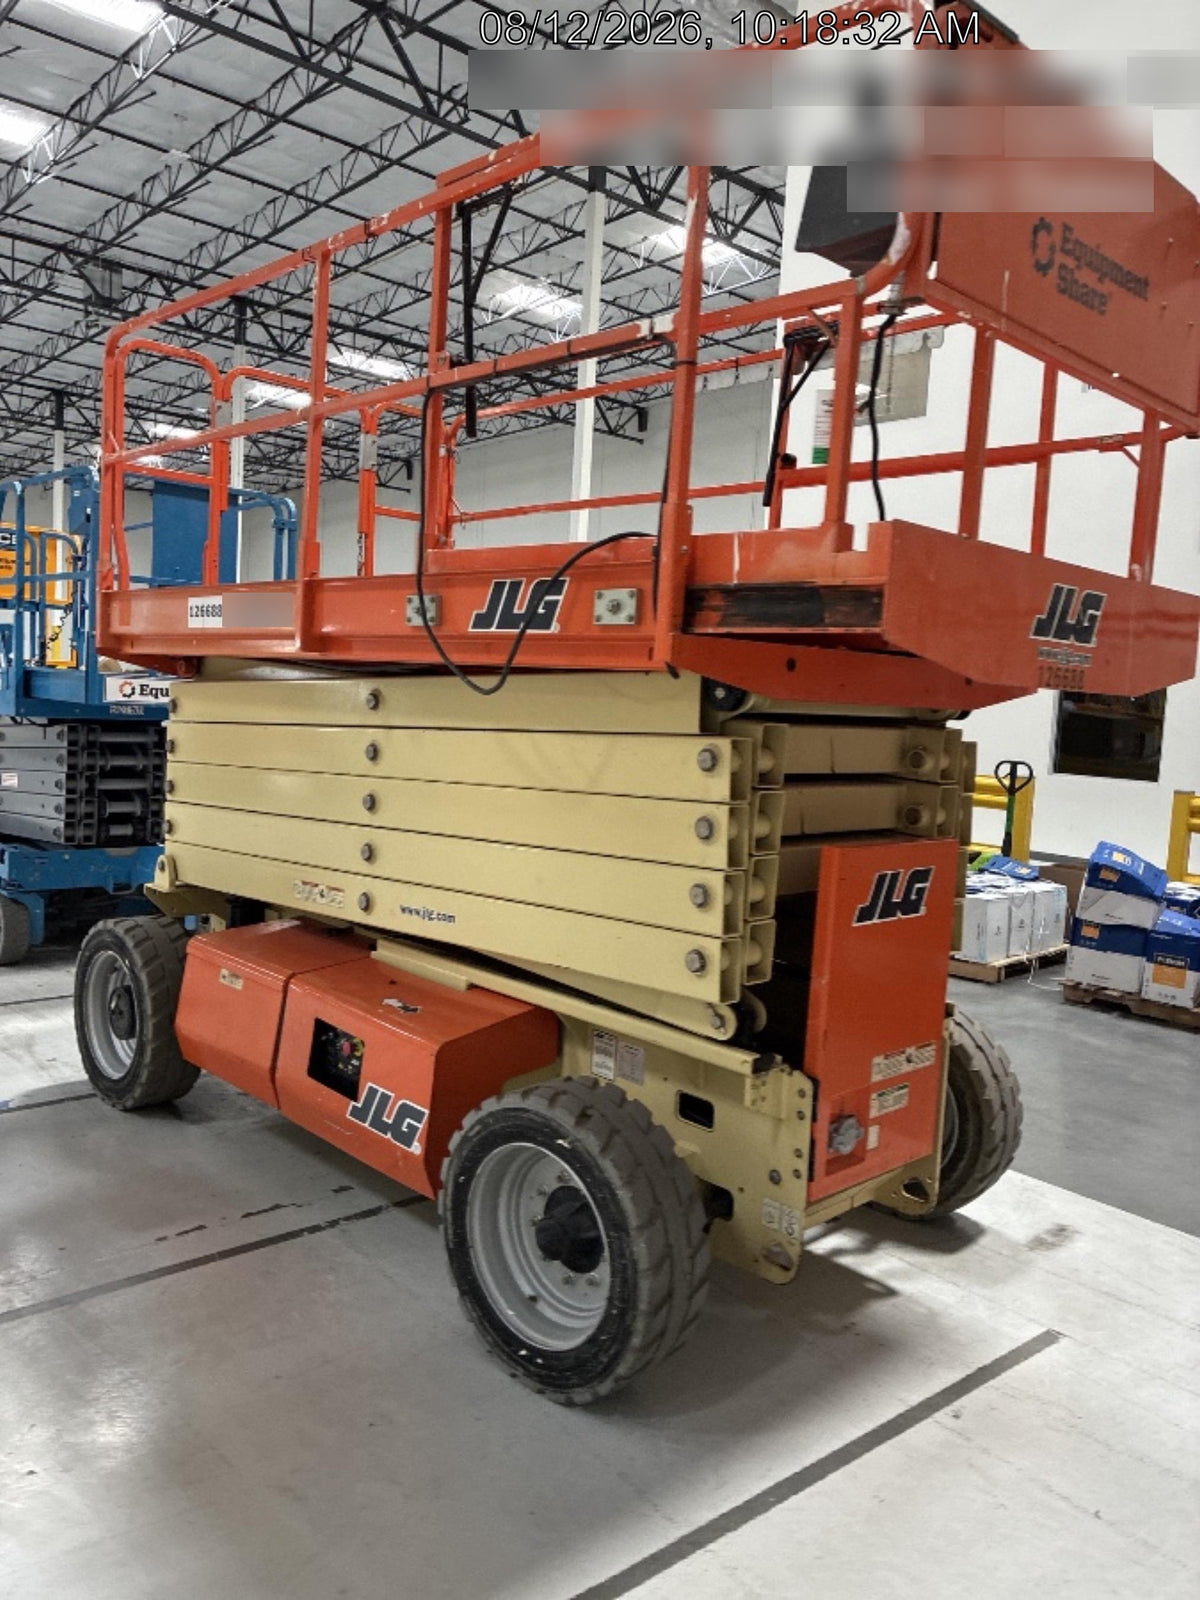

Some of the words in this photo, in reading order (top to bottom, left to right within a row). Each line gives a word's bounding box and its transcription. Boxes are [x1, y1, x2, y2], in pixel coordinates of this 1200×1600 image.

[1057, 262, 1109, 316] Share
[1060, 221, 1150, 301] Equipment
[469, 577, 571, 633] JLG
[1030, 583, 1108, 647] JLG
[138, 684, 170, 699] Equ
[400, 904, 456, 924] www.jlg.com
[853, 866, 934, 927] JLG
[347, 1082, 430, 1152] JLG
